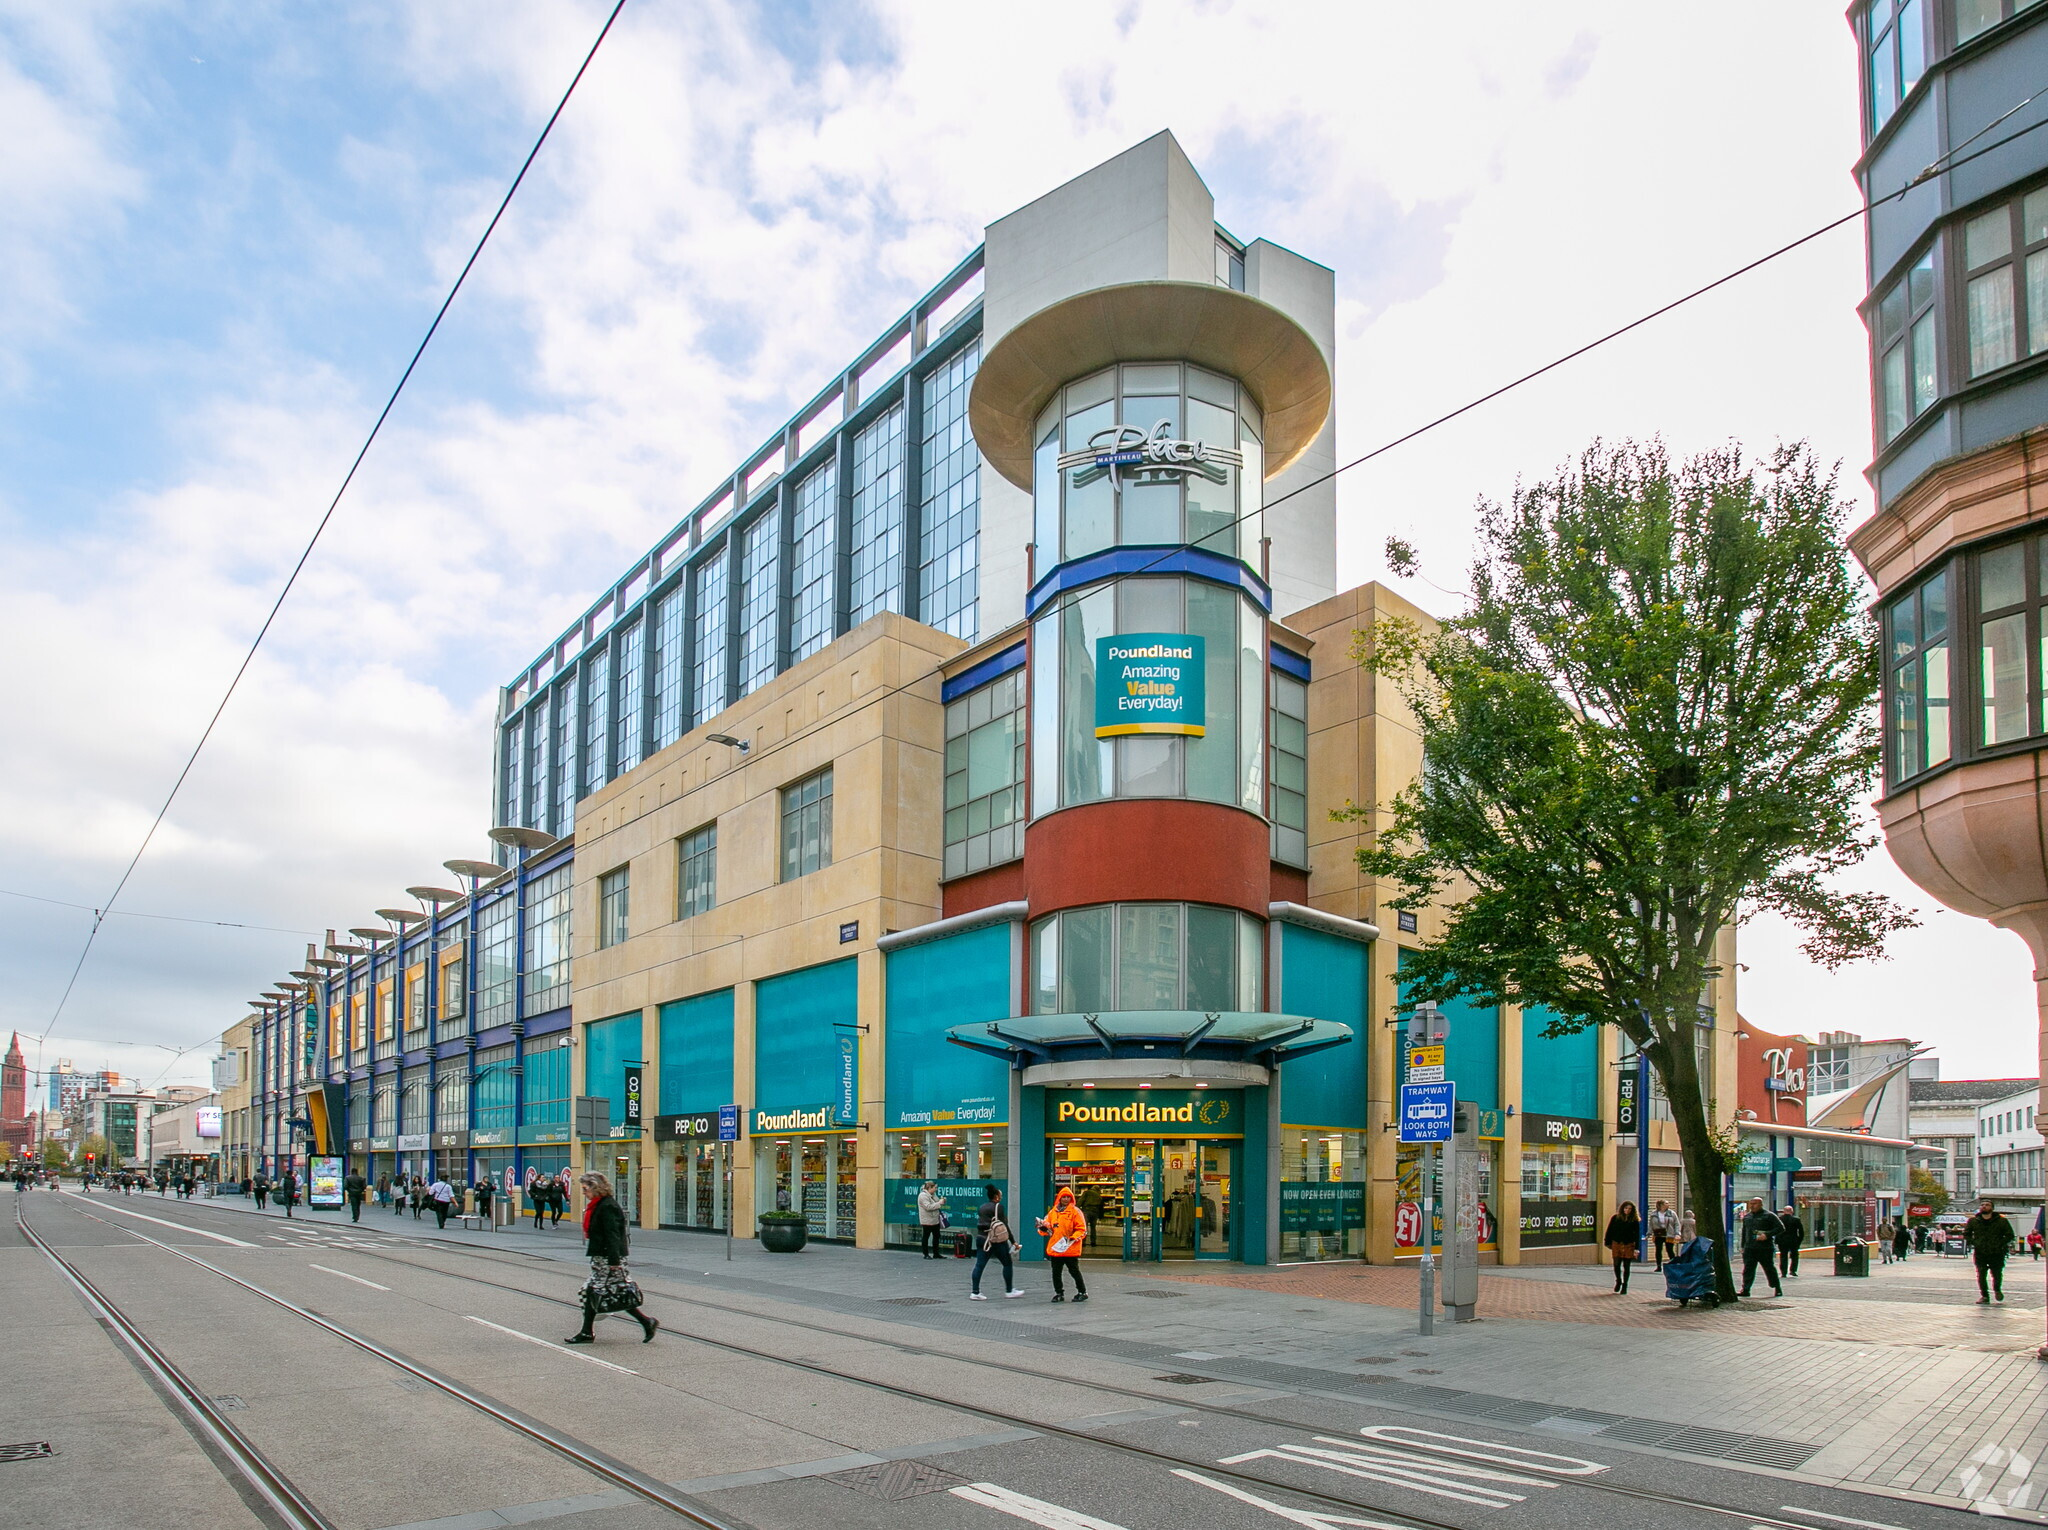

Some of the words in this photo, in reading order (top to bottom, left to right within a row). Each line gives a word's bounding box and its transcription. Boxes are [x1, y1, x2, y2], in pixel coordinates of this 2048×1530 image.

[1097, 453, 1141, 464] MARTINEAU
[1109, 645, 1192, 660] Poundland
[1121, 664, 1180, 681] Amazing
[1127, 680, 1175, 696] Value
[1118, 696, 1182, 712] Everyday!
[841, 1054, 852, 1118] Poundland
[1408, 1087, 1448, 1096] TRAMWAY
[757, 1107, 826, 1131] Poundland
[901, 1110, 931, 1123] Amazing
[932, 1109, 956, 1121] Value
[957, 1105, 995, 1121] Everyday!
[1059, 1101, 1193, 1122] Poundland
[1404, 1122, 1427, 1130] LOOK
[1428, 1121, 1450, 1129] BOTH
[474, 1131, 501, 1144] Poundland
[1415, 1130, 1438, 1138] WAYS
[904, 1186, 918, 1196] NOW
[937, 1186, 953, 1196] EVEN
[955, 1186, 983, 1197] LONGER!
[1283, 1189, 1299, 1200] NOW
[1300, 1189, 1318, 1200] OPEN
[1319, 1189, 1336, 1199] EVEN
[1336, 1189, 1362, 1199] LONGER!
[1396, 1208, 1418, 1242] £1
[1520, 1215, 1541, 1229] EP&CO
